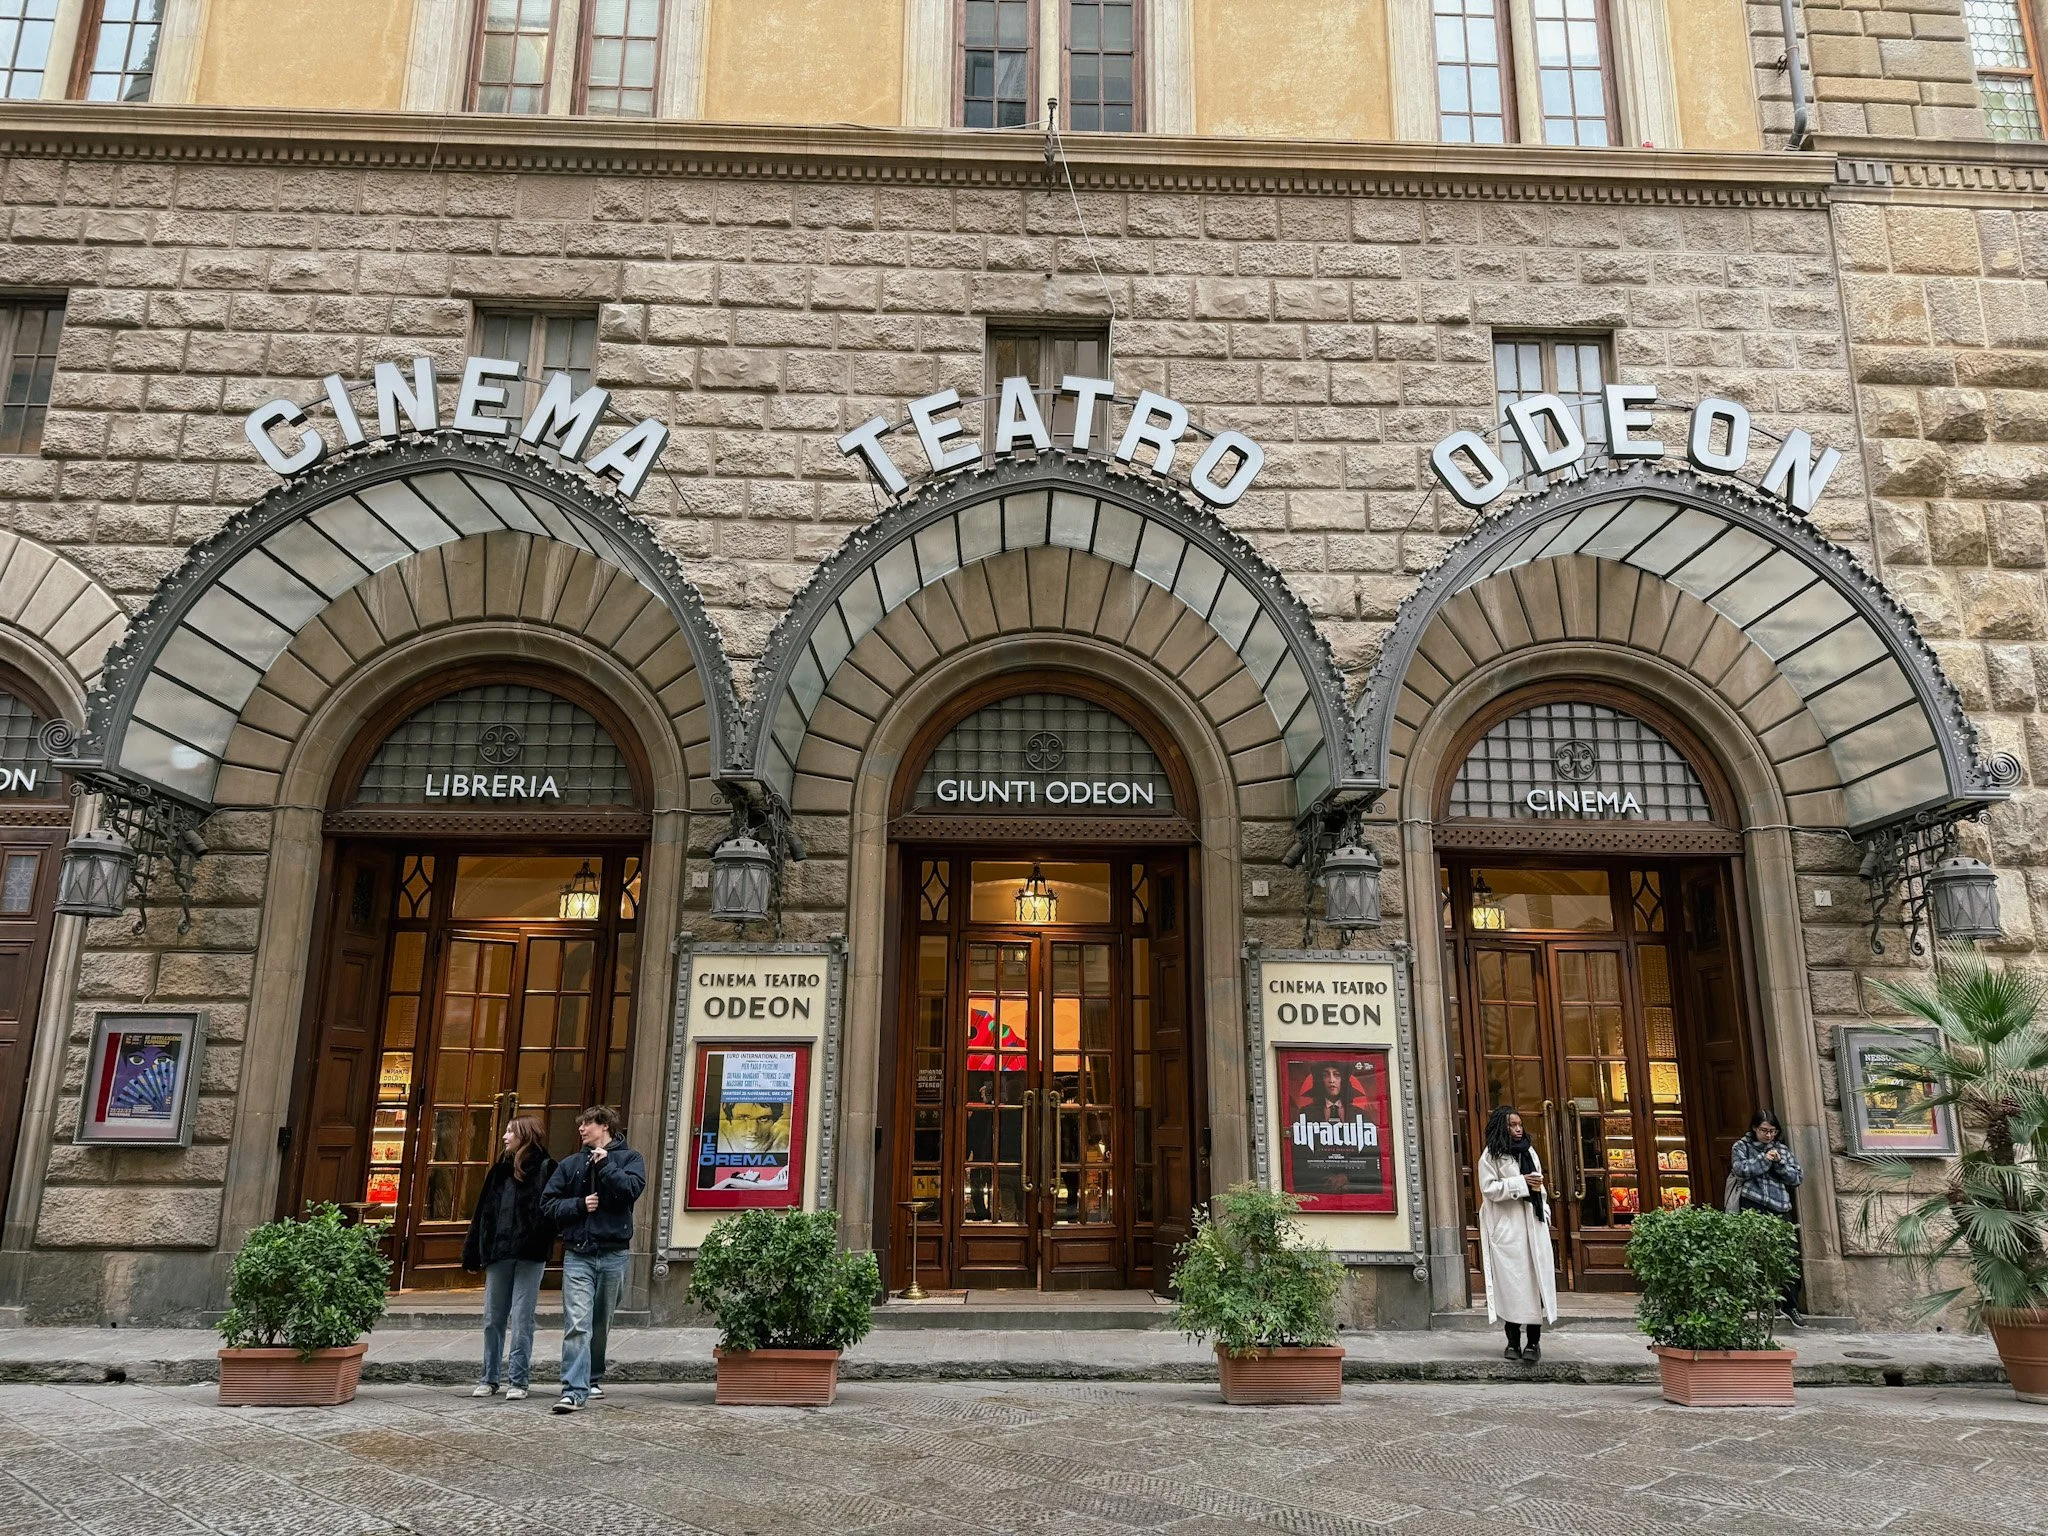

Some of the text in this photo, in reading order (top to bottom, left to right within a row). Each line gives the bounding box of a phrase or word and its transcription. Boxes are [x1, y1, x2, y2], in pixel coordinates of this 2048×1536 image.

[244, 356, 1842, 515] CINEMA TEATRO ODEON
[425, 773, 561, 798] LIBRERIA
[936, 779, 1154, 804] GIUNTI ODEON
[1526, 789, 1642, 813] CINEMA
[699, 973, 820, 988] CINEMA TEATRO
[1269, 980, 1388, 995] CINEMA TEATRO
[704, 996, 810, 1019] ODEON
[1277, 1003, 1381, 1026] ODEON
[1293, 1113, 1378, 1153] dracula
